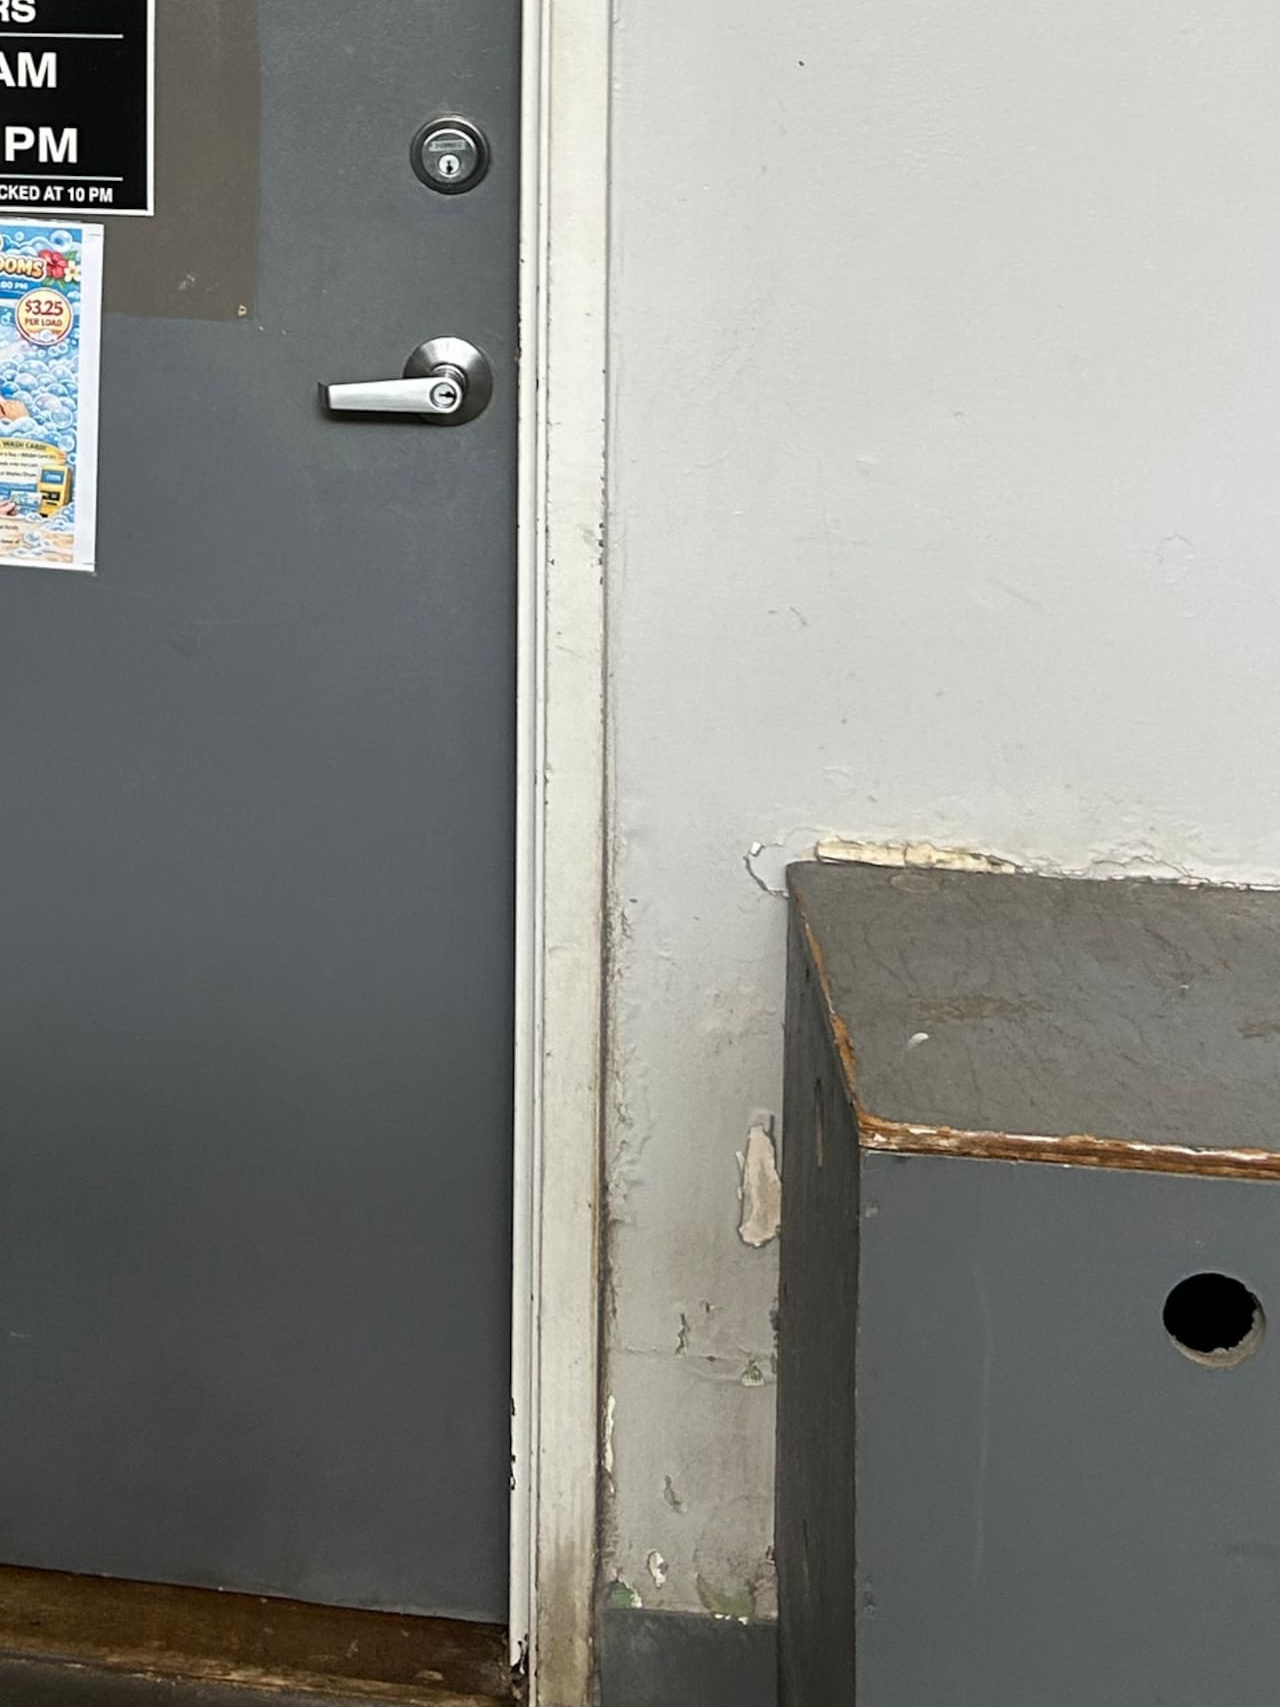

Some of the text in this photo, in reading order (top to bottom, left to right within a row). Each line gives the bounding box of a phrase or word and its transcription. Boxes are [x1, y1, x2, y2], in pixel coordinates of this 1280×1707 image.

[4, 126, 78, 164] PM
[43, 185, 64, 202] AT
[67, 186, 86, 202] 10
[88, 187, 113, 203] PM
